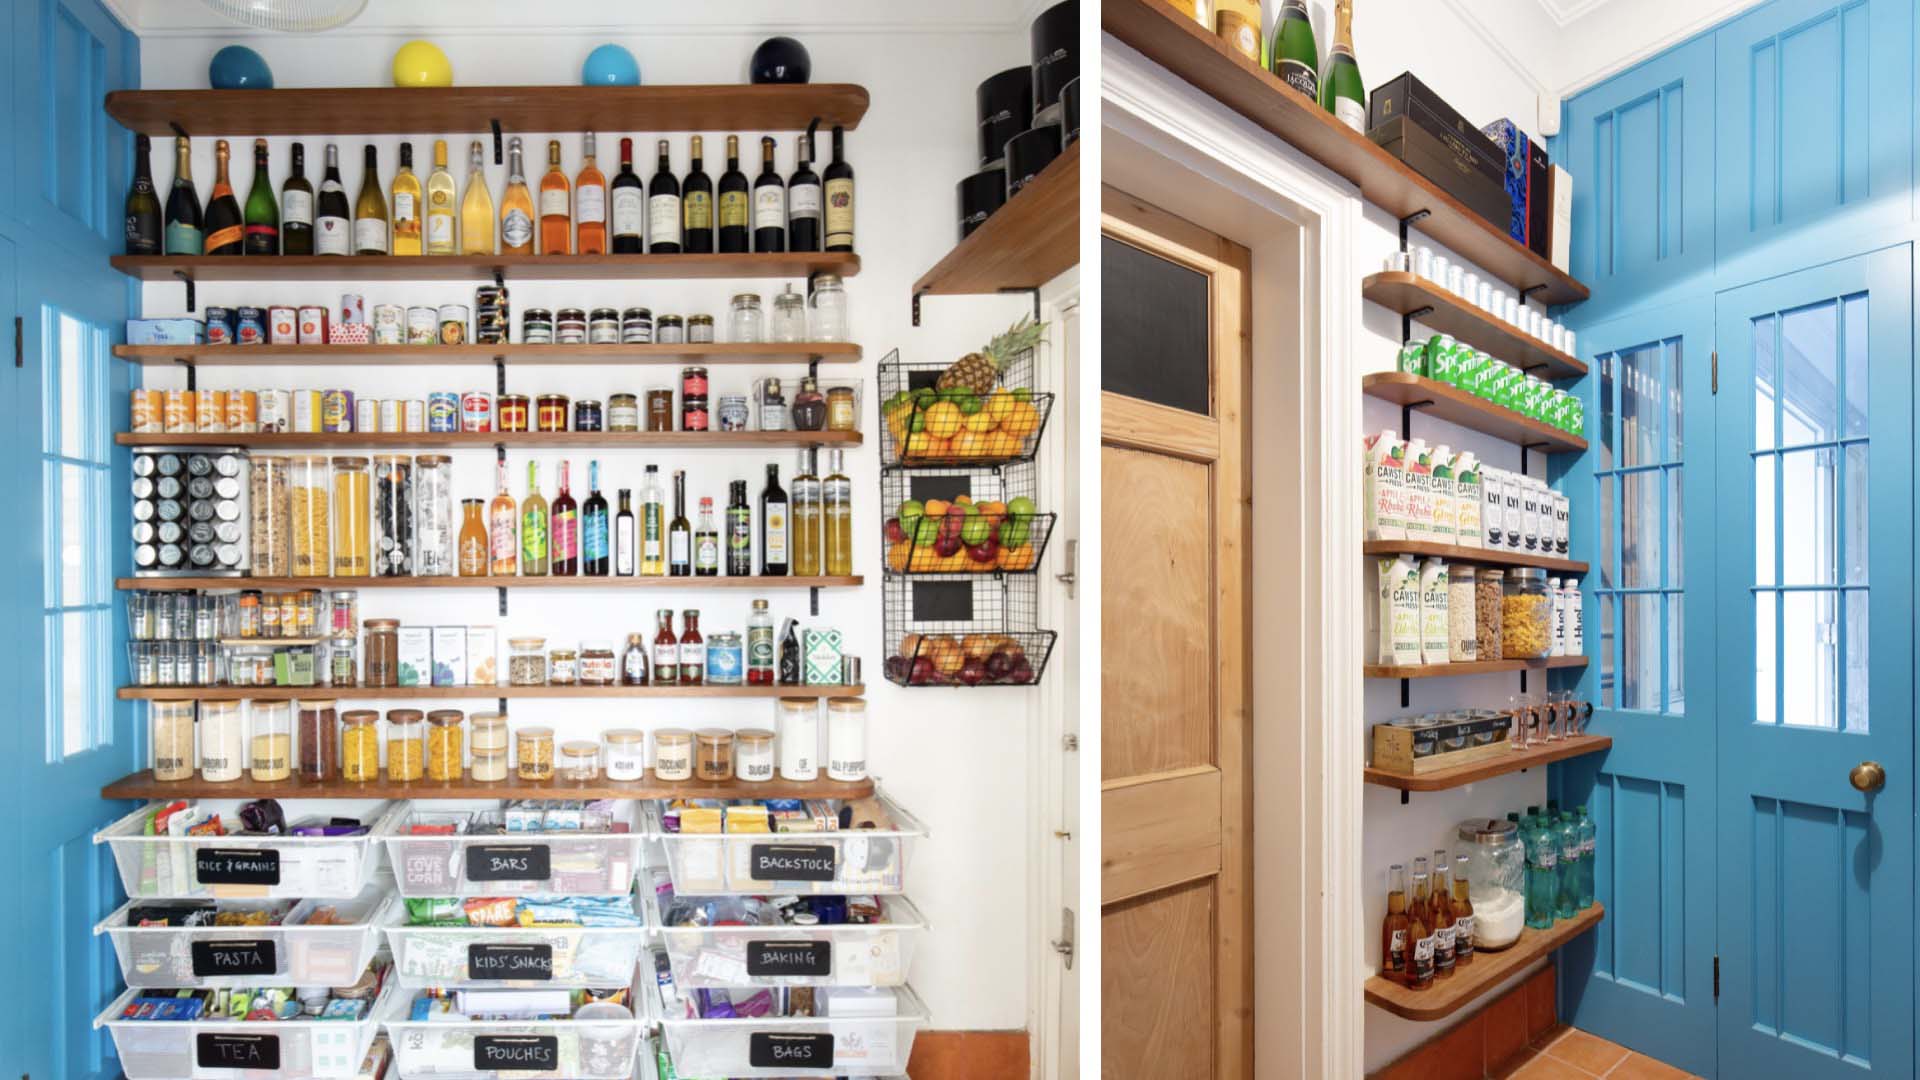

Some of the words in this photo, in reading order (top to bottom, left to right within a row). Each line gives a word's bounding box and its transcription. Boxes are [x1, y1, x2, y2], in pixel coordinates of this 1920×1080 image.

[747, 765, 771, 776] SUGAR
[198, 860, 225, 873] RICE
[235, 860, 276, 873] GRAINS
[407, 857, 443, 872] LOVE
[490, 857, 528, 872] BARS
[759, 855, 834, 872] BACKSTOCK
[407, 871, 443, 884] CORN
[213, 950, 263, 967] PASTA
[474, 955, 509, 969] KIDS'
[509, 954, 553, 970] SNACKS
[759, 951, 816, 967] BAKING
[216, 1043, 261, 1061] TEA
[485, 1045, 552, 1062] POUCHES
[772, 1044, 813, 1060] BAGS
